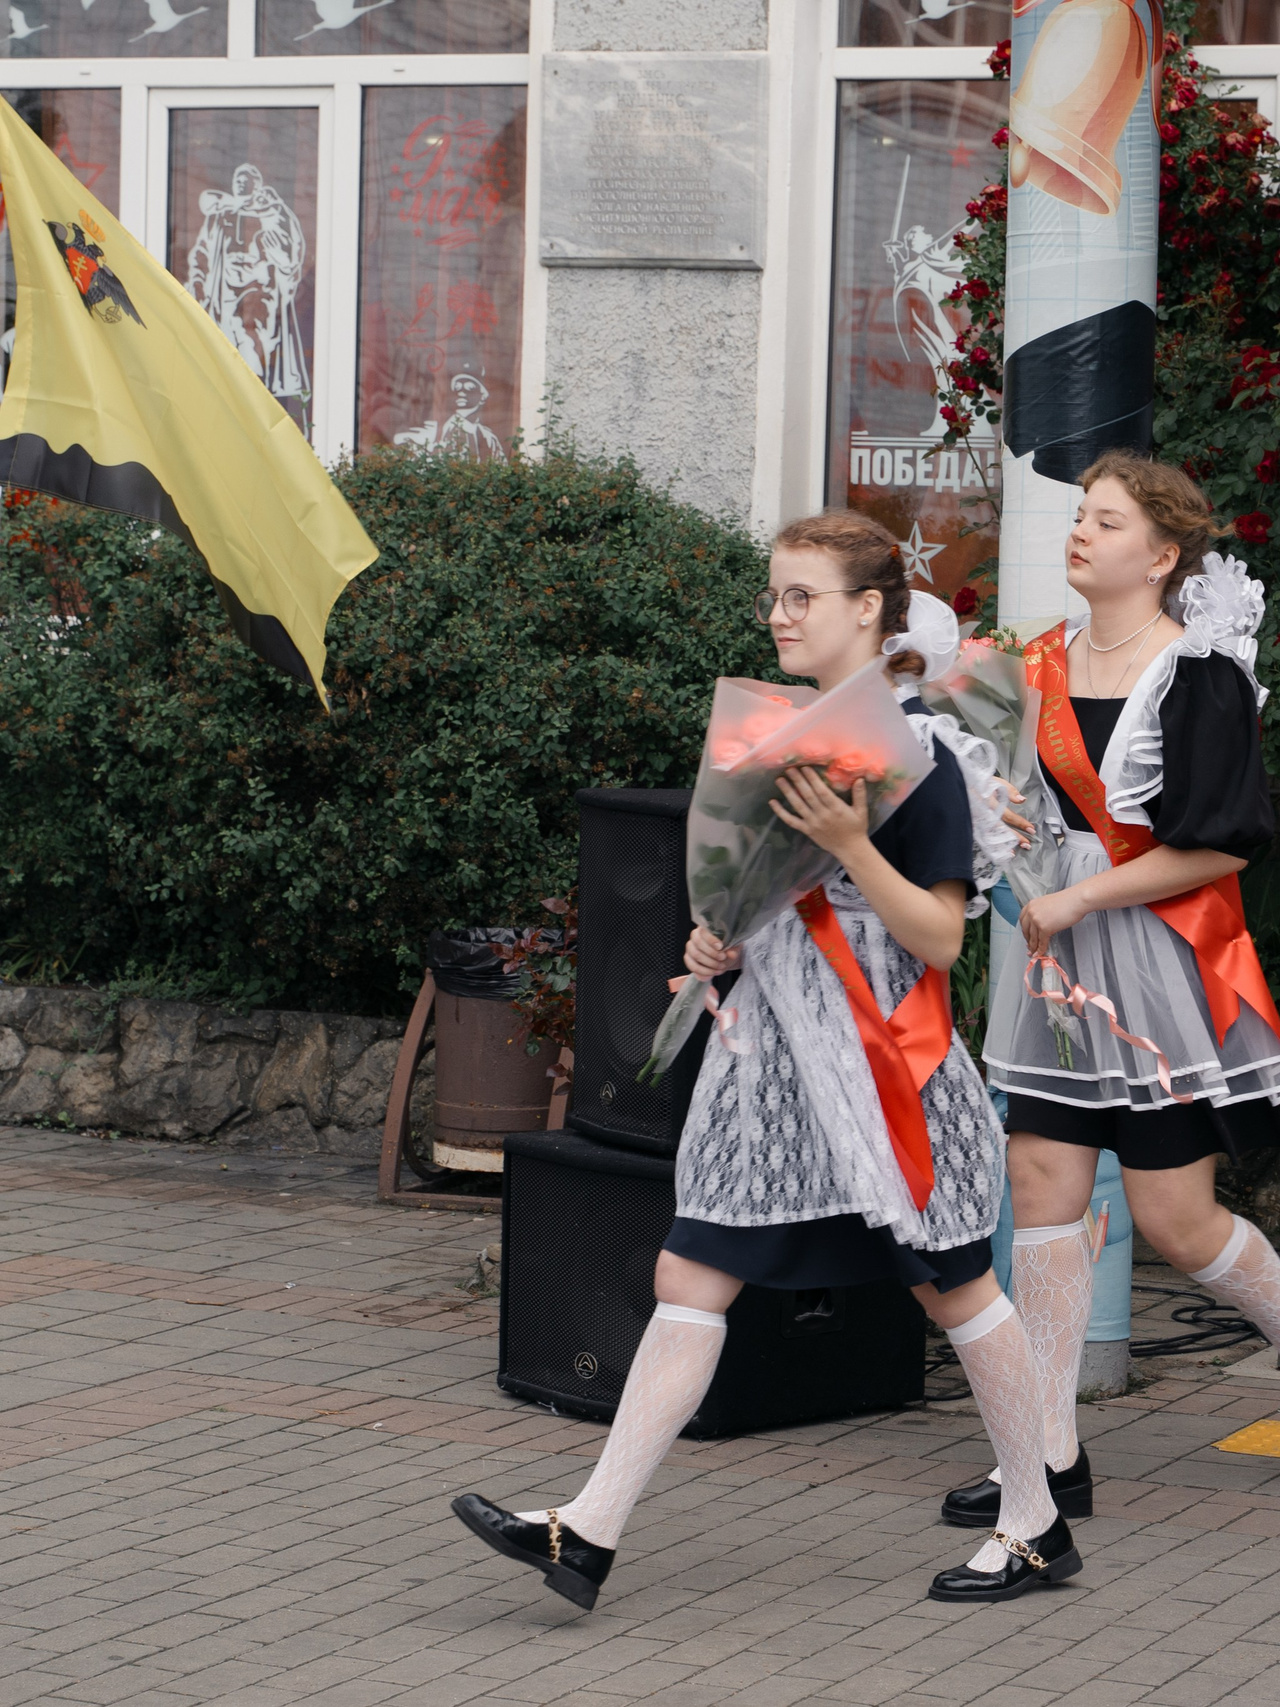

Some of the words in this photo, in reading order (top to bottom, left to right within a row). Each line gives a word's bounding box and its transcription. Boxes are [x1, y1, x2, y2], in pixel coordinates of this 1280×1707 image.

[402, 114, 453, 189] 9
[398, 183, 504, 228] мая
[850, 447, 996, 494] ПОБЕДА!
